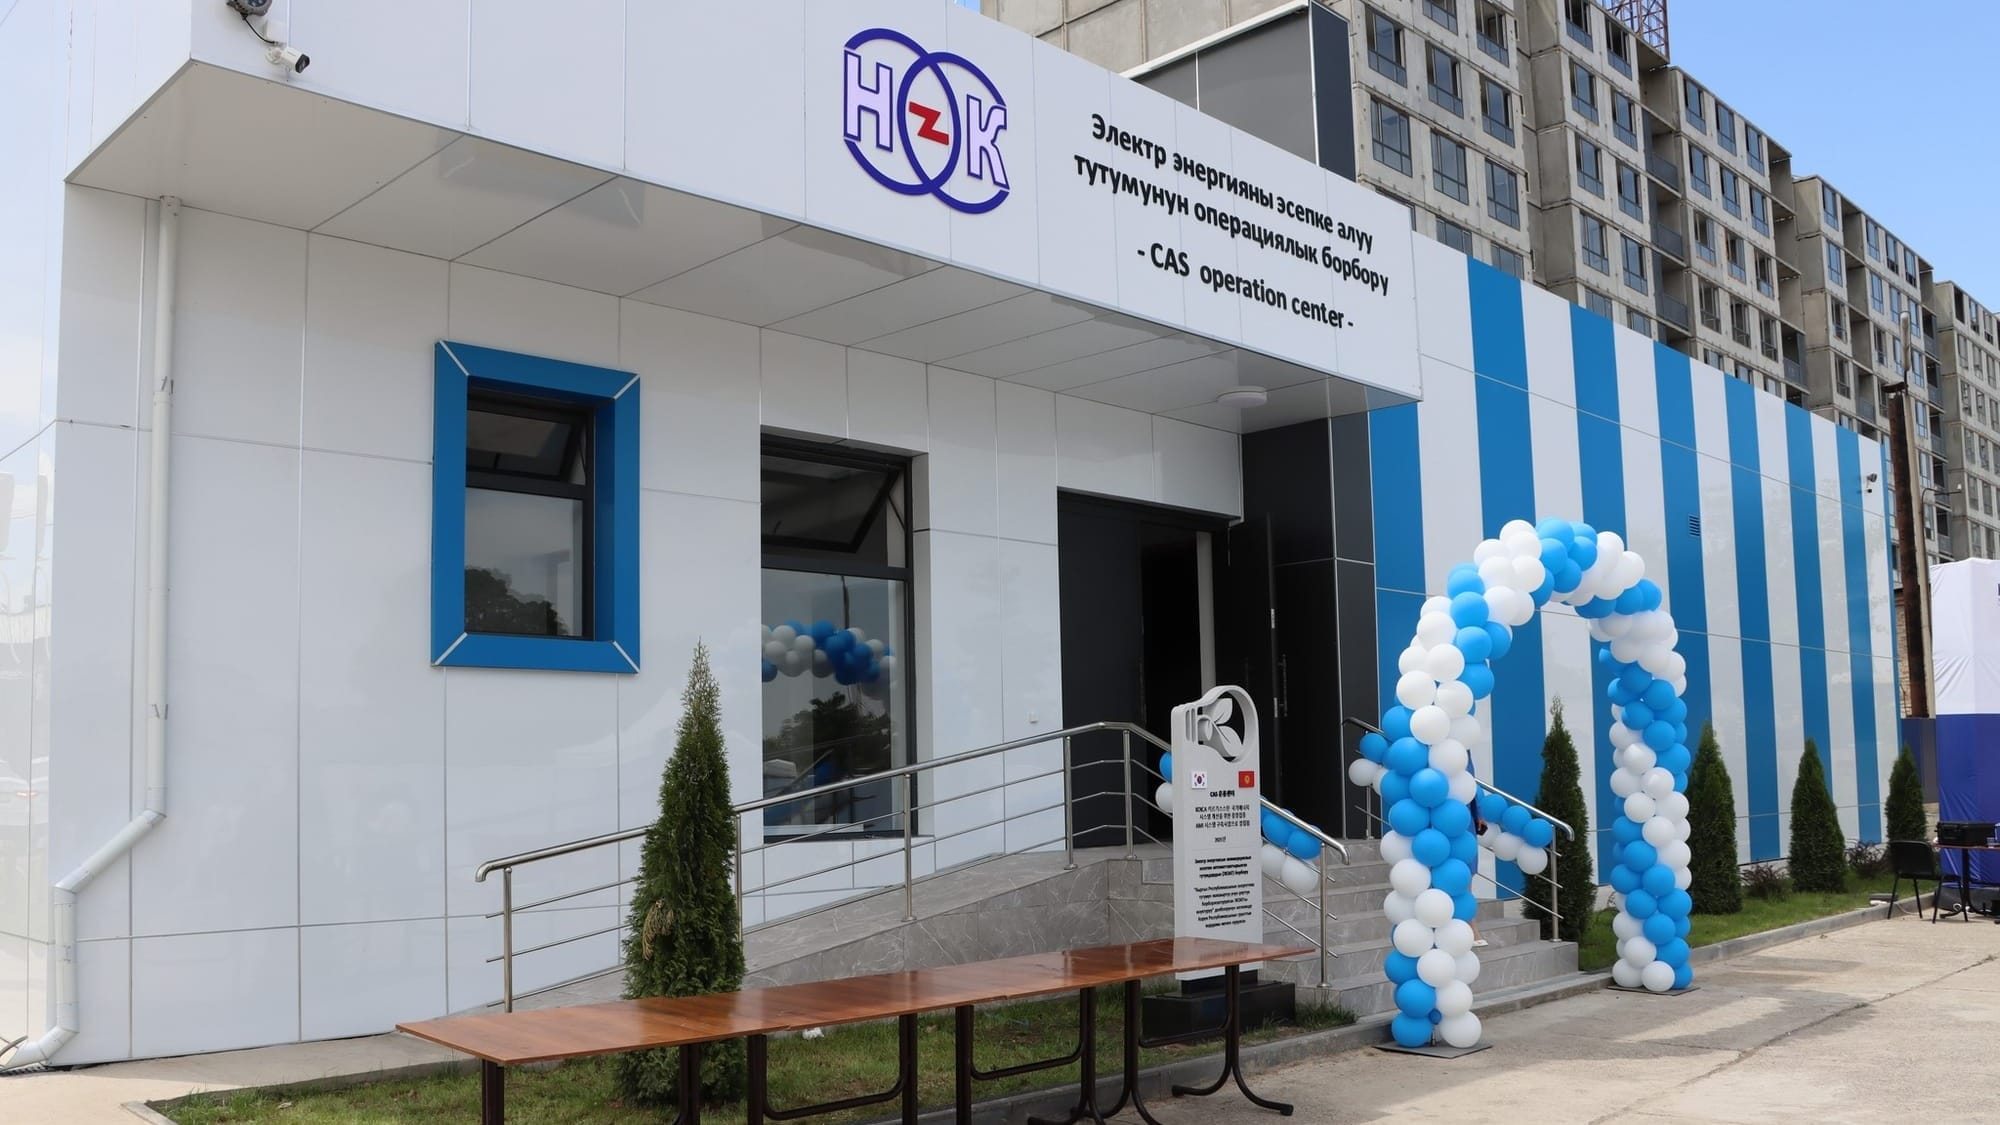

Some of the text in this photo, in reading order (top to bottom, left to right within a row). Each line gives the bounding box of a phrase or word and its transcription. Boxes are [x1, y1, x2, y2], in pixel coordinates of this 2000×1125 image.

[1074, 154, 1389, 297] тутумунун операциялык борбору
[1091, 113, 1373, 255] Электр энергияны эсепке алуу
[1150, 242, 1190, 277] CAS
[1200, 265, 1287, 310] operation
